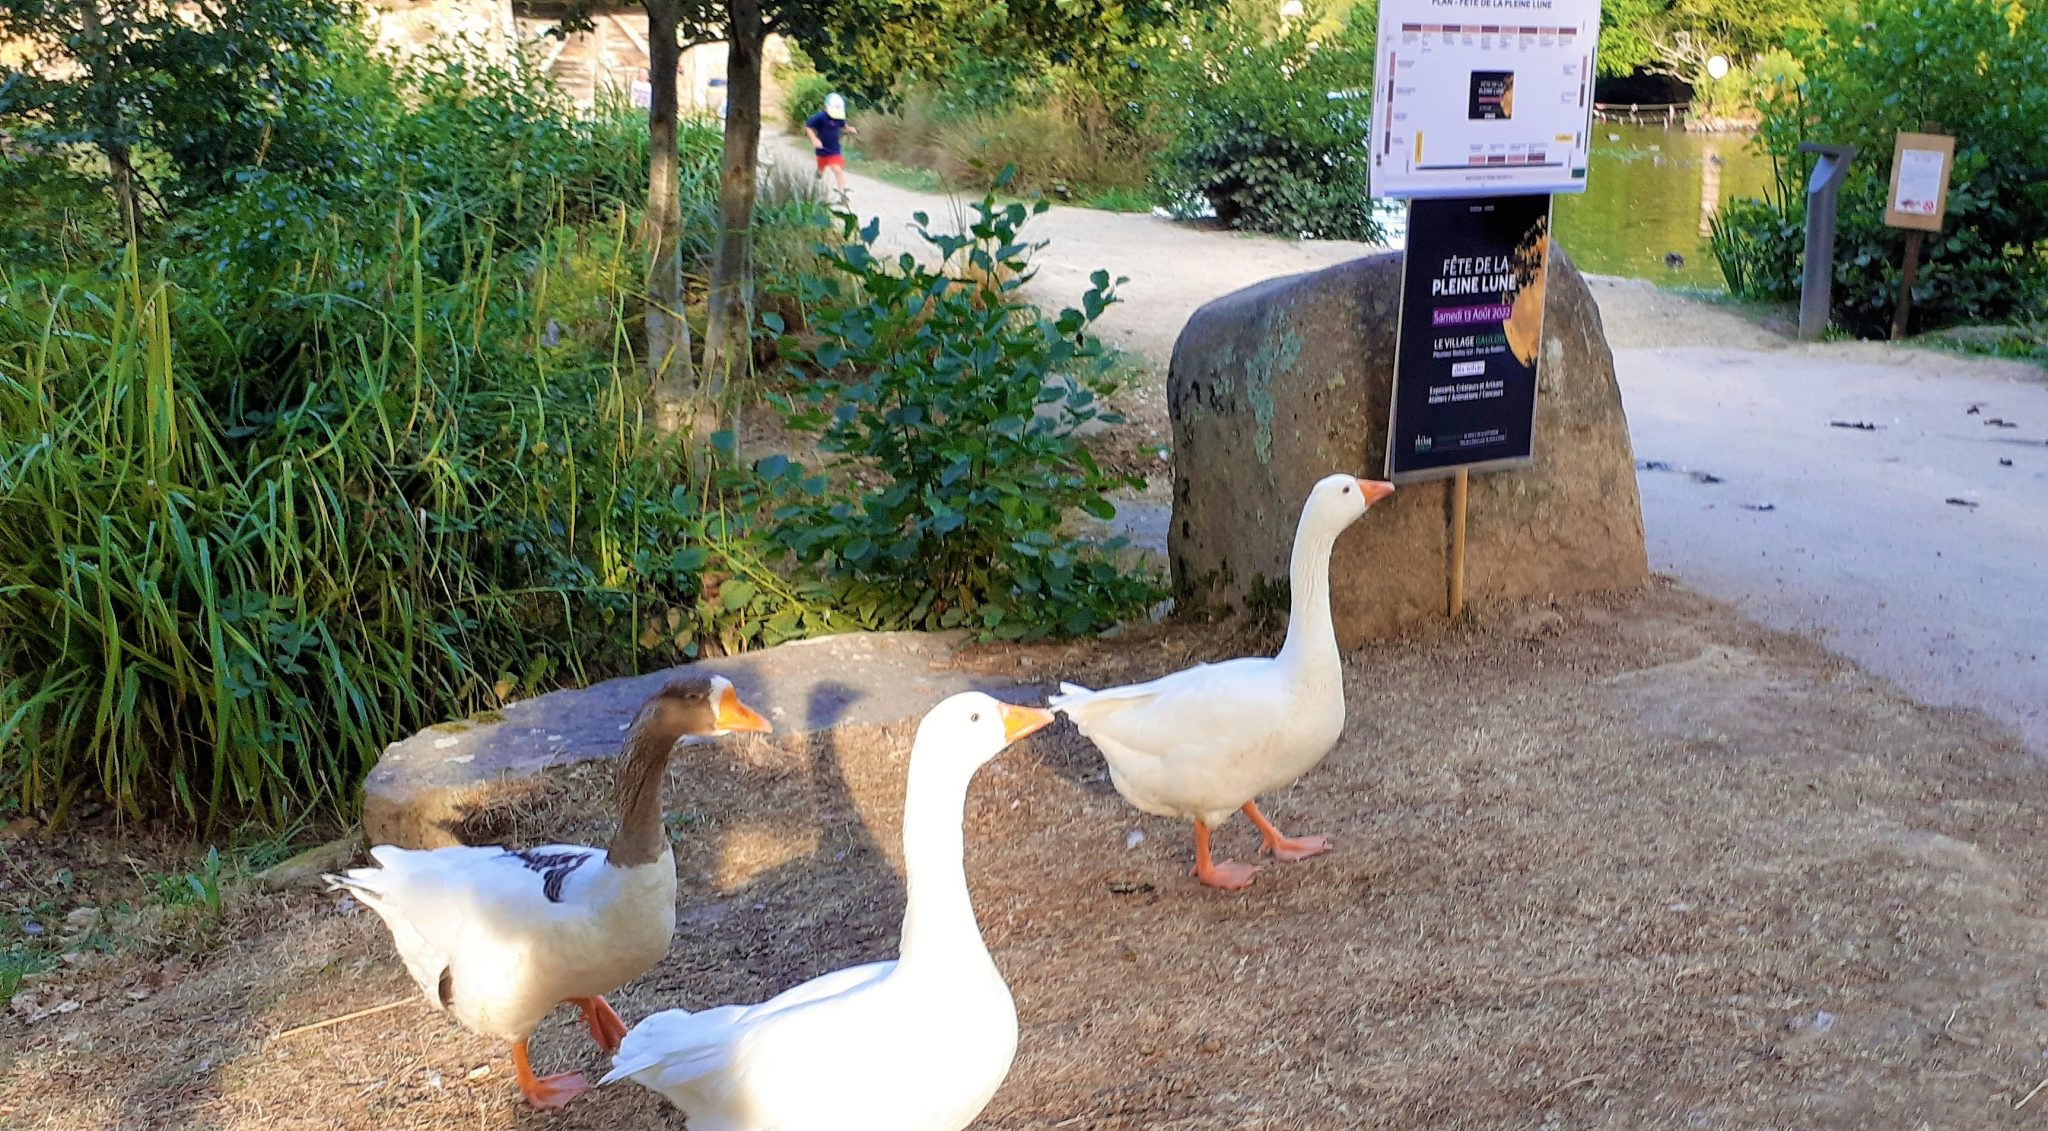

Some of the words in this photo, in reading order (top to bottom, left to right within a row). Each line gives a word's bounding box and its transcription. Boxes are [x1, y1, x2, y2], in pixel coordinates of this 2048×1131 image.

[1493, 0, 1503, 8] LA
[1504, 0, 1531, 8] PLEINE
[1532, 0, 1552, 9] LUNE
[1443, 255, 1473, 277] FÊTE
[1475, 256, 1491, 275] DE
[1494, 255, 1509, 274] LA
[1432, 276, 1479, 297] PLEINE
[1482, 273, 1516, 294] LUNE
[1433, 309, 1463, 324] Samedi
[1464, 309, 1471, 322] 13
[1472, 306, 1490, 321] Août
[1434, 337, 1443, 350] LE
[1444, 335, 1475, 349] VILLAGE
